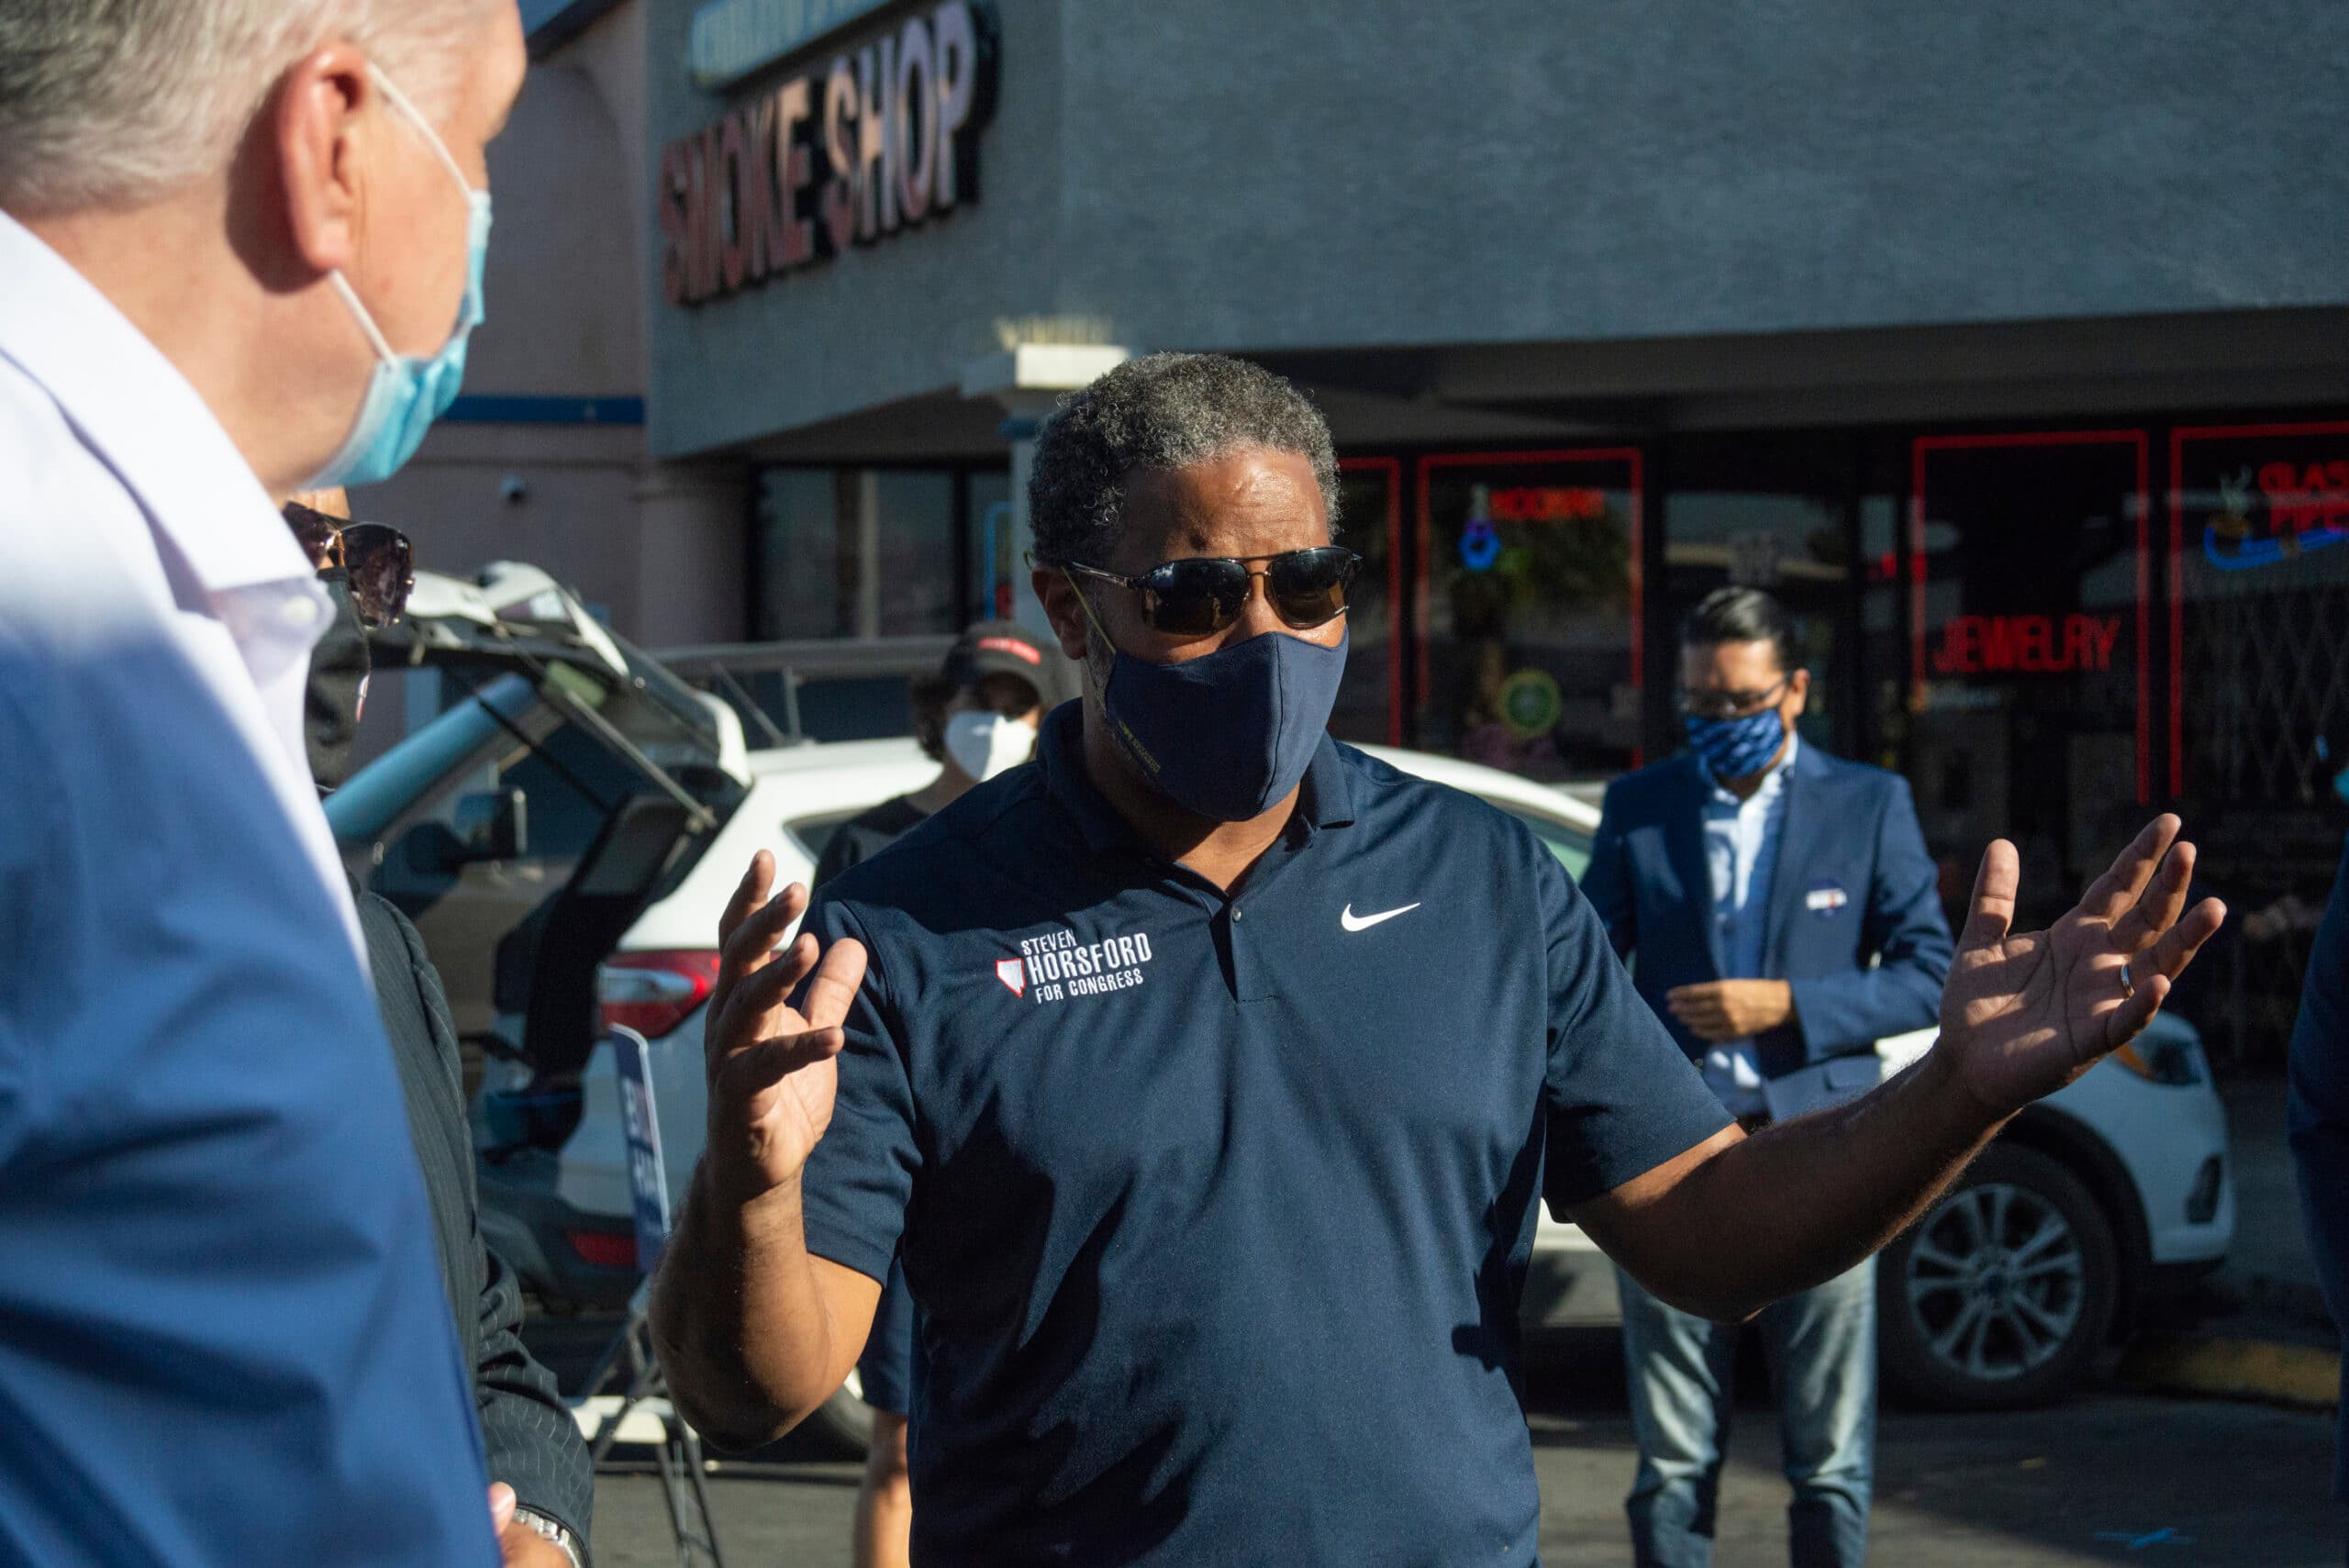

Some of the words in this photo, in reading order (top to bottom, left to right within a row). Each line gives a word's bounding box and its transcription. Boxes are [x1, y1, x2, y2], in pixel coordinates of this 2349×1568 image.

[659, 76, 814, 308] SMOKE
[824, 1, 976, 250] SHOP
[1933, 613, 2121, 673] JEWELRY
[1020, 929, 1078, 956] STEVEN
[1026, 932, 1152, 985] HORSFORD
[1034, 984, 1064, 1005] FOR
[1068, 968, 1144, 996] CONGRESS
